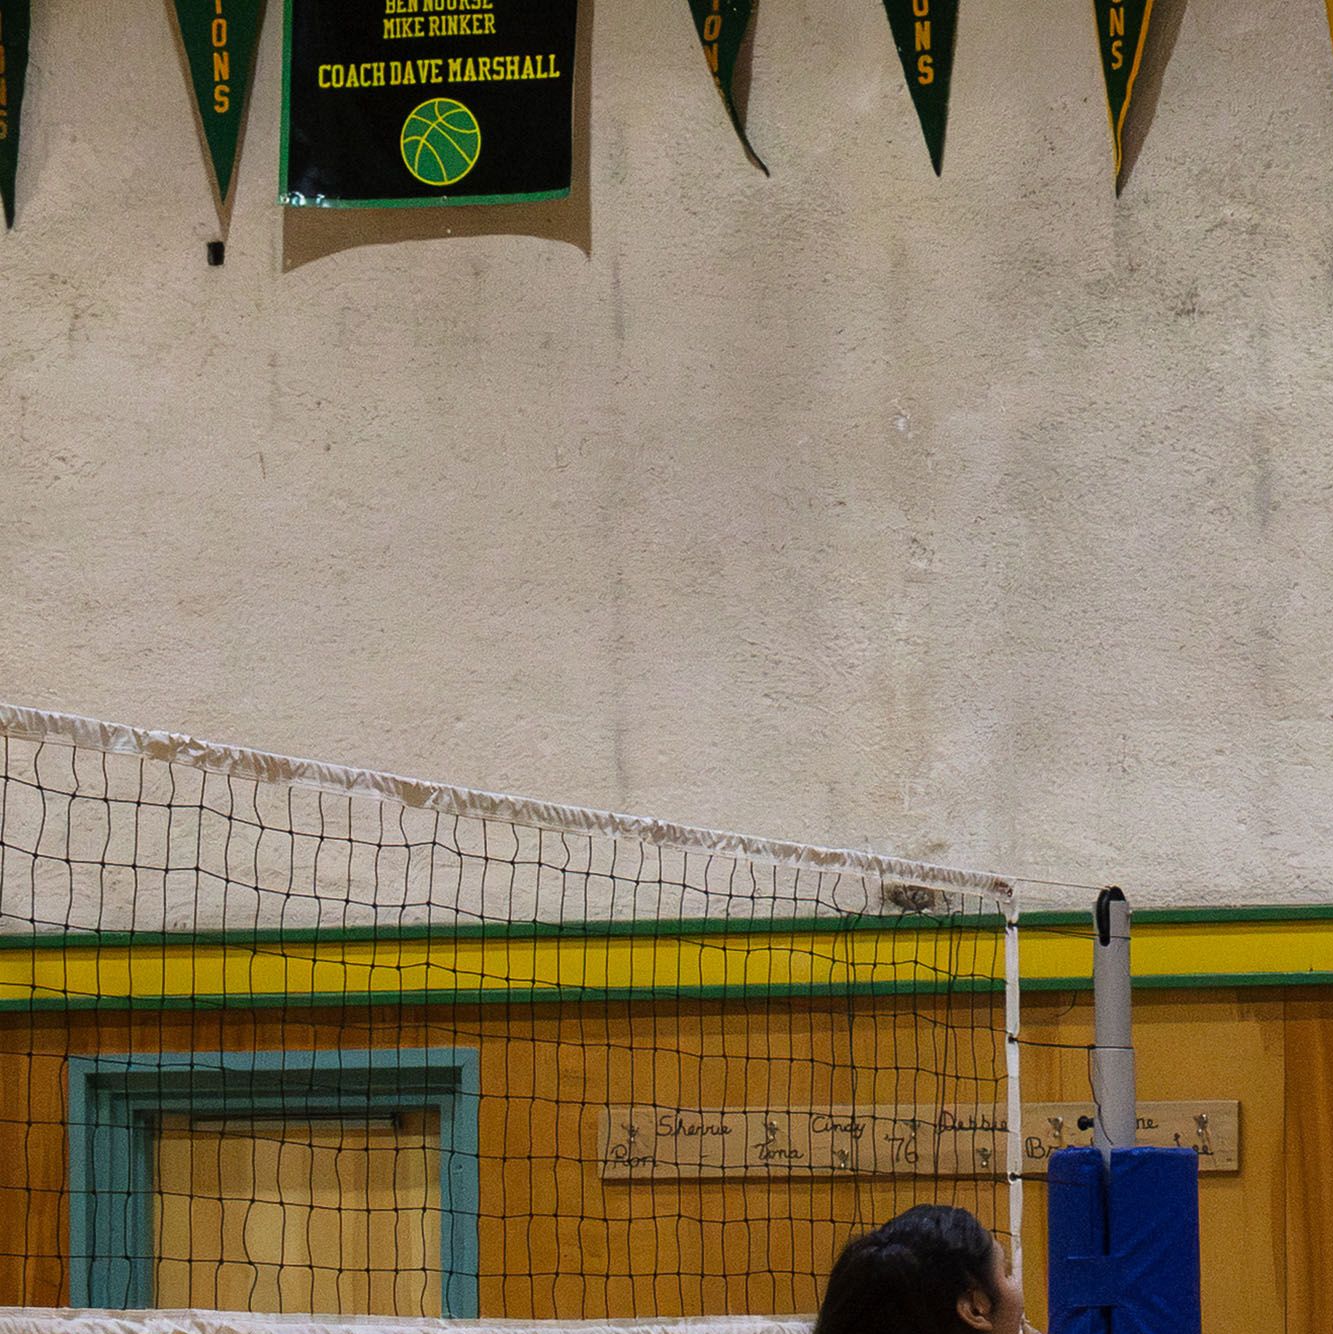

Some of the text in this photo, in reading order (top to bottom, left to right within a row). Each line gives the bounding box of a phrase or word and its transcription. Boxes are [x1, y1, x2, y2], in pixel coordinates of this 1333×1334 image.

[383, 13, 496, 39] MIKE RINKER
[318, 54, 560, 88] COACH DAVE MARSHALL
[812, 1116, 866, 1139] Cindy
